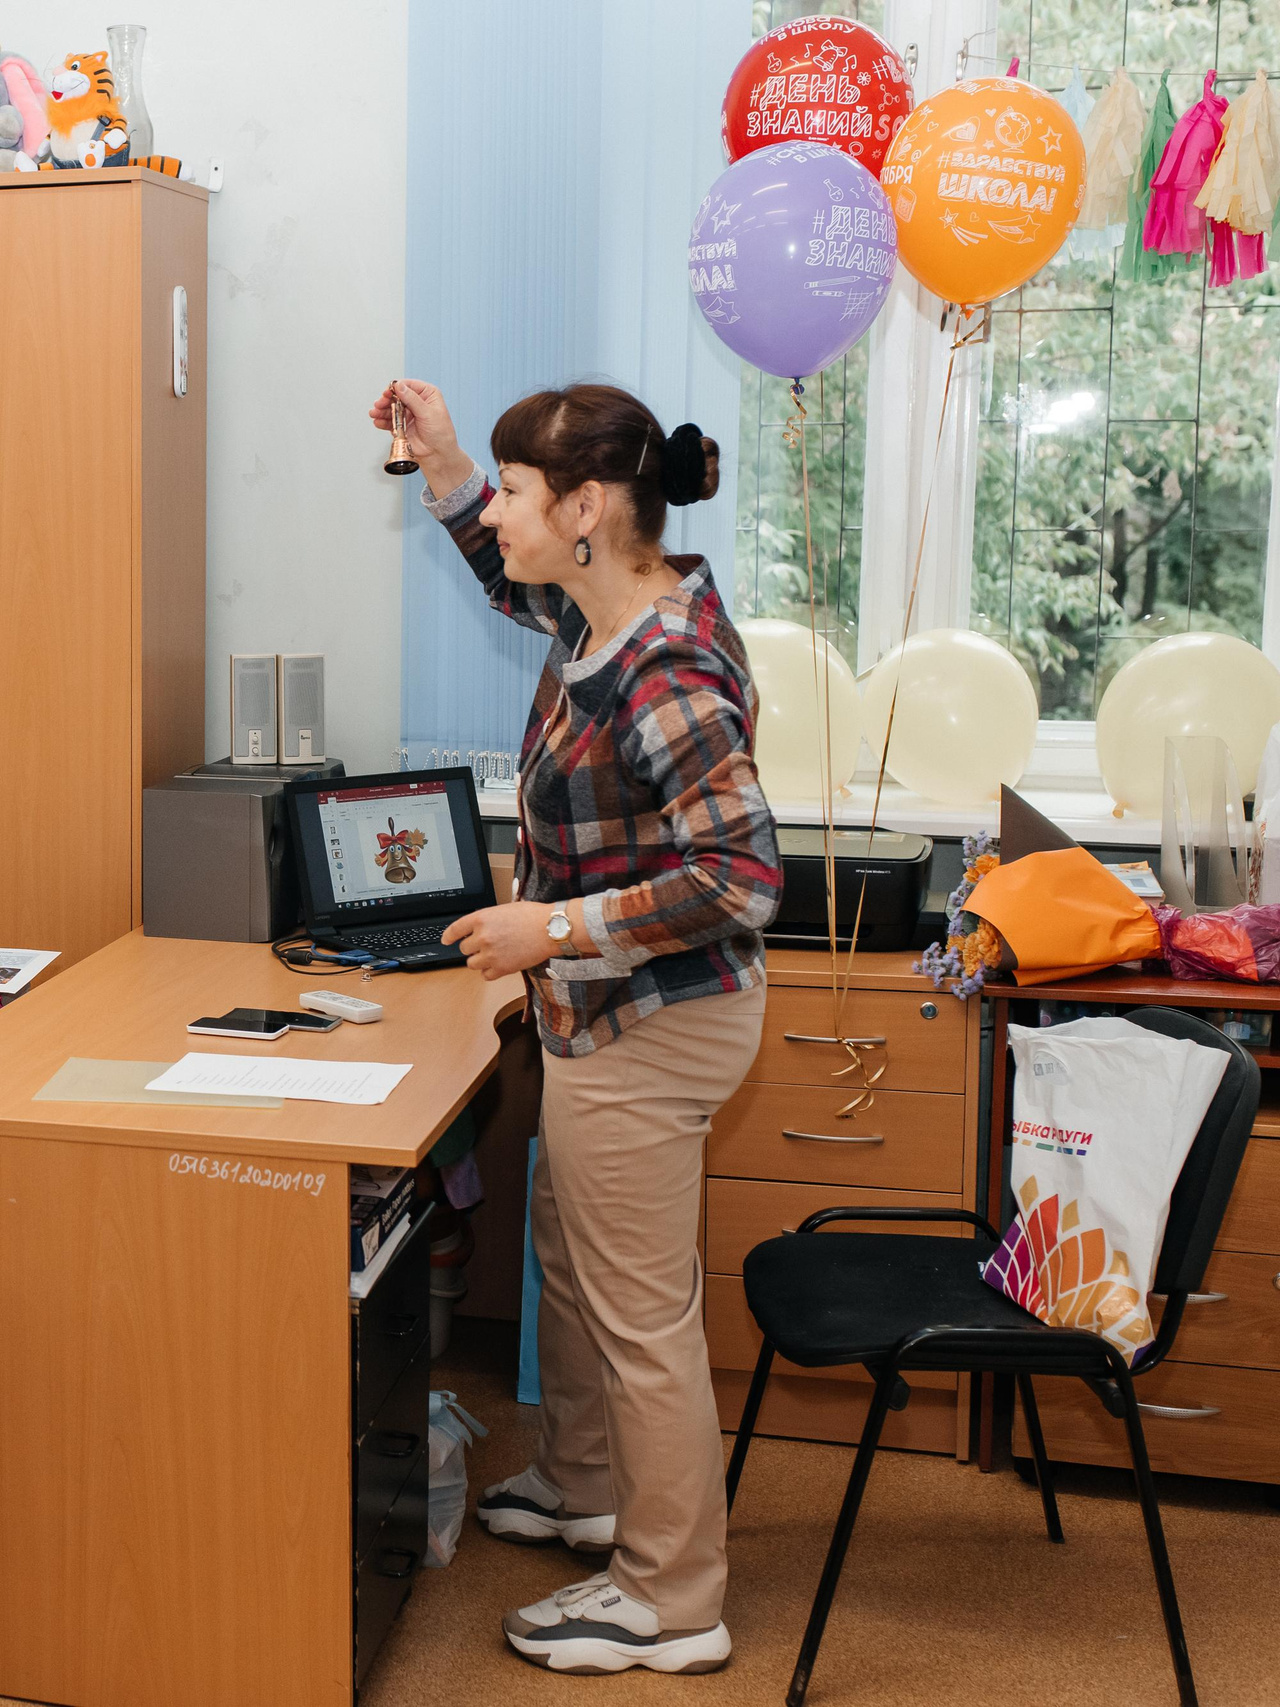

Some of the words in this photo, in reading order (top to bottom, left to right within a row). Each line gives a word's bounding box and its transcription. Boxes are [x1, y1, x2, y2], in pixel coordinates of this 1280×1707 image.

[750, 74, 861, 111] #ДЕНЬ
[747, 105, 872, 137] ЗНАНИЙ
[936, 150, 1066, 184] #ЗДРАВСТВУЙ
[937, 172, 1058, 214] ШКОЛА!
[813, 205, 897, 247] #ДЕНЬ
